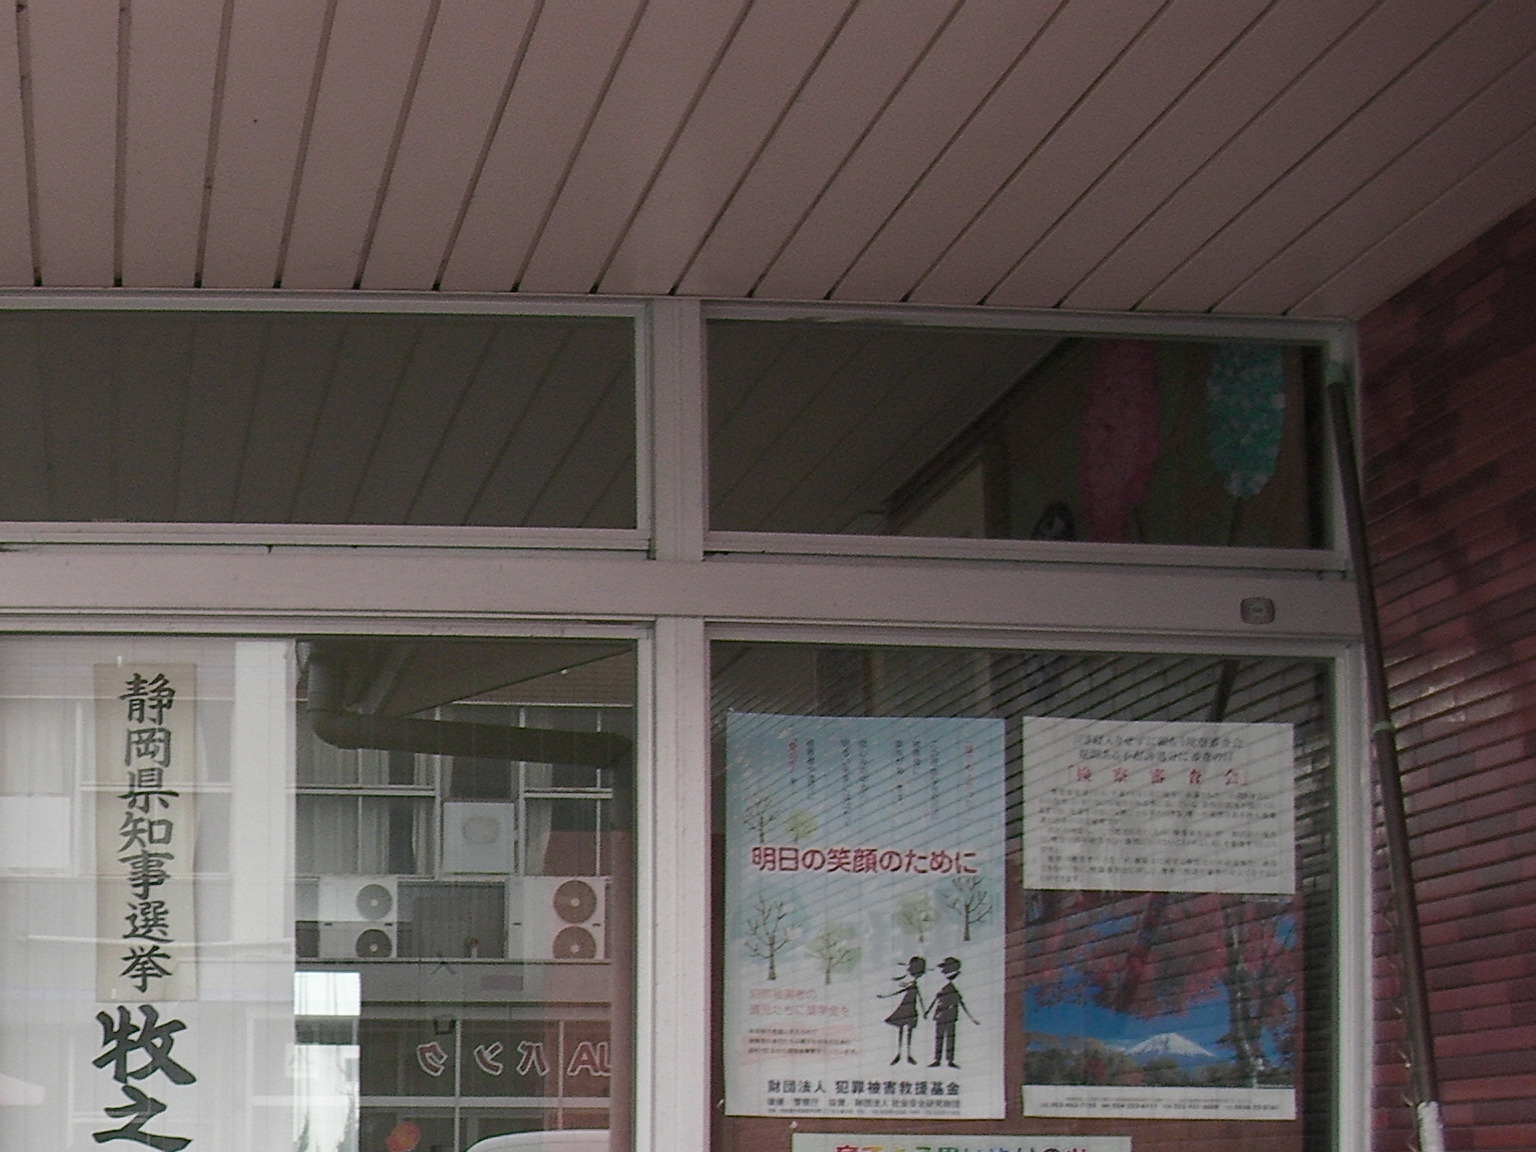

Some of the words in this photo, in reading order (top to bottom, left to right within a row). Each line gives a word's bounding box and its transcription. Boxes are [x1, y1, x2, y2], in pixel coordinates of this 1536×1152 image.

[118, 672, 178, 994] 静岡県知事選挙
[751, 846, 979, 875] 明日の笑顔のために
[767, 1080, 826, 1094] 財団法人
[835, 1080, 961, 1096] 犯罪被害救援基金
